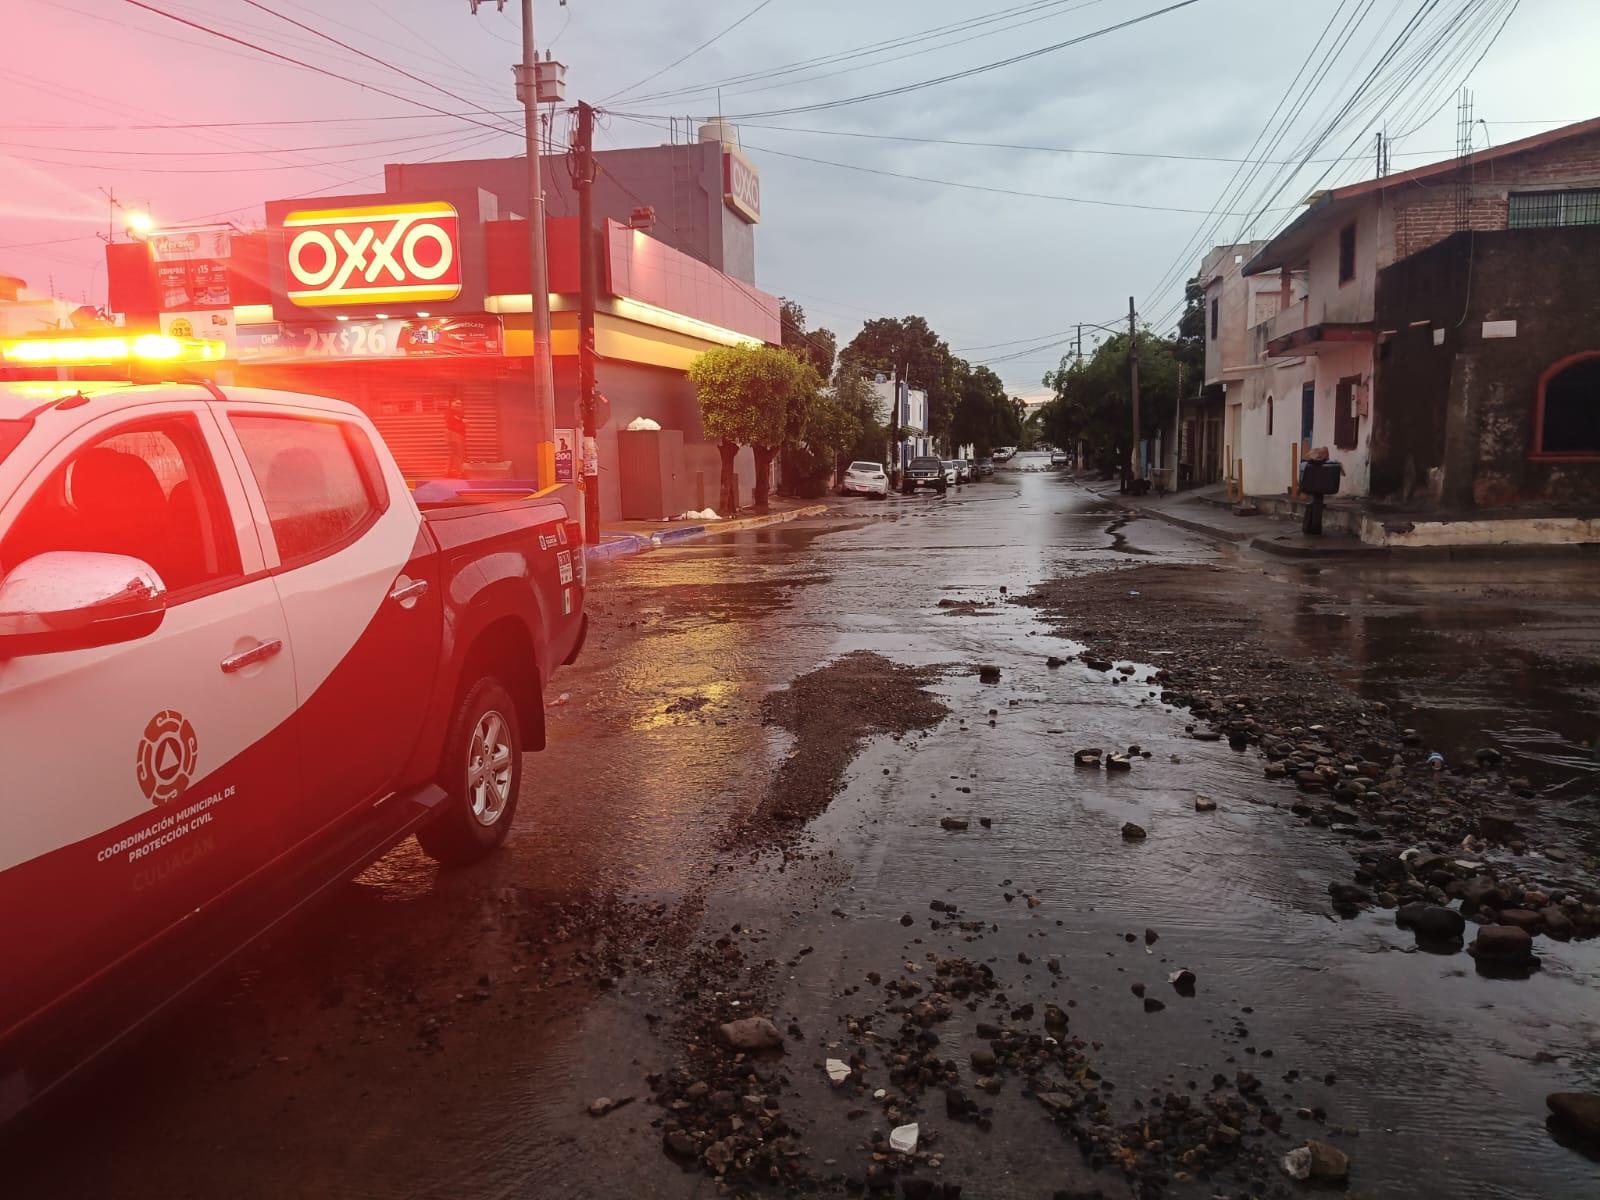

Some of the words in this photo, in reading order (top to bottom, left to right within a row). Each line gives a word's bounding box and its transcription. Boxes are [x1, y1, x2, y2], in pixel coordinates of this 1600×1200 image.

[733, 164, 759, 208] OXXO
[289, 220, 453, 289] OXXO
[97, 816, 174, 862] COORDINACIÓN
[176, 792, 223, 823] MUNICIPAL
[224, 785, 236, 799] DE
[128, 824, 189, 863] PROTECCIÓN
[190, 812, 214, 830] CIVIL
